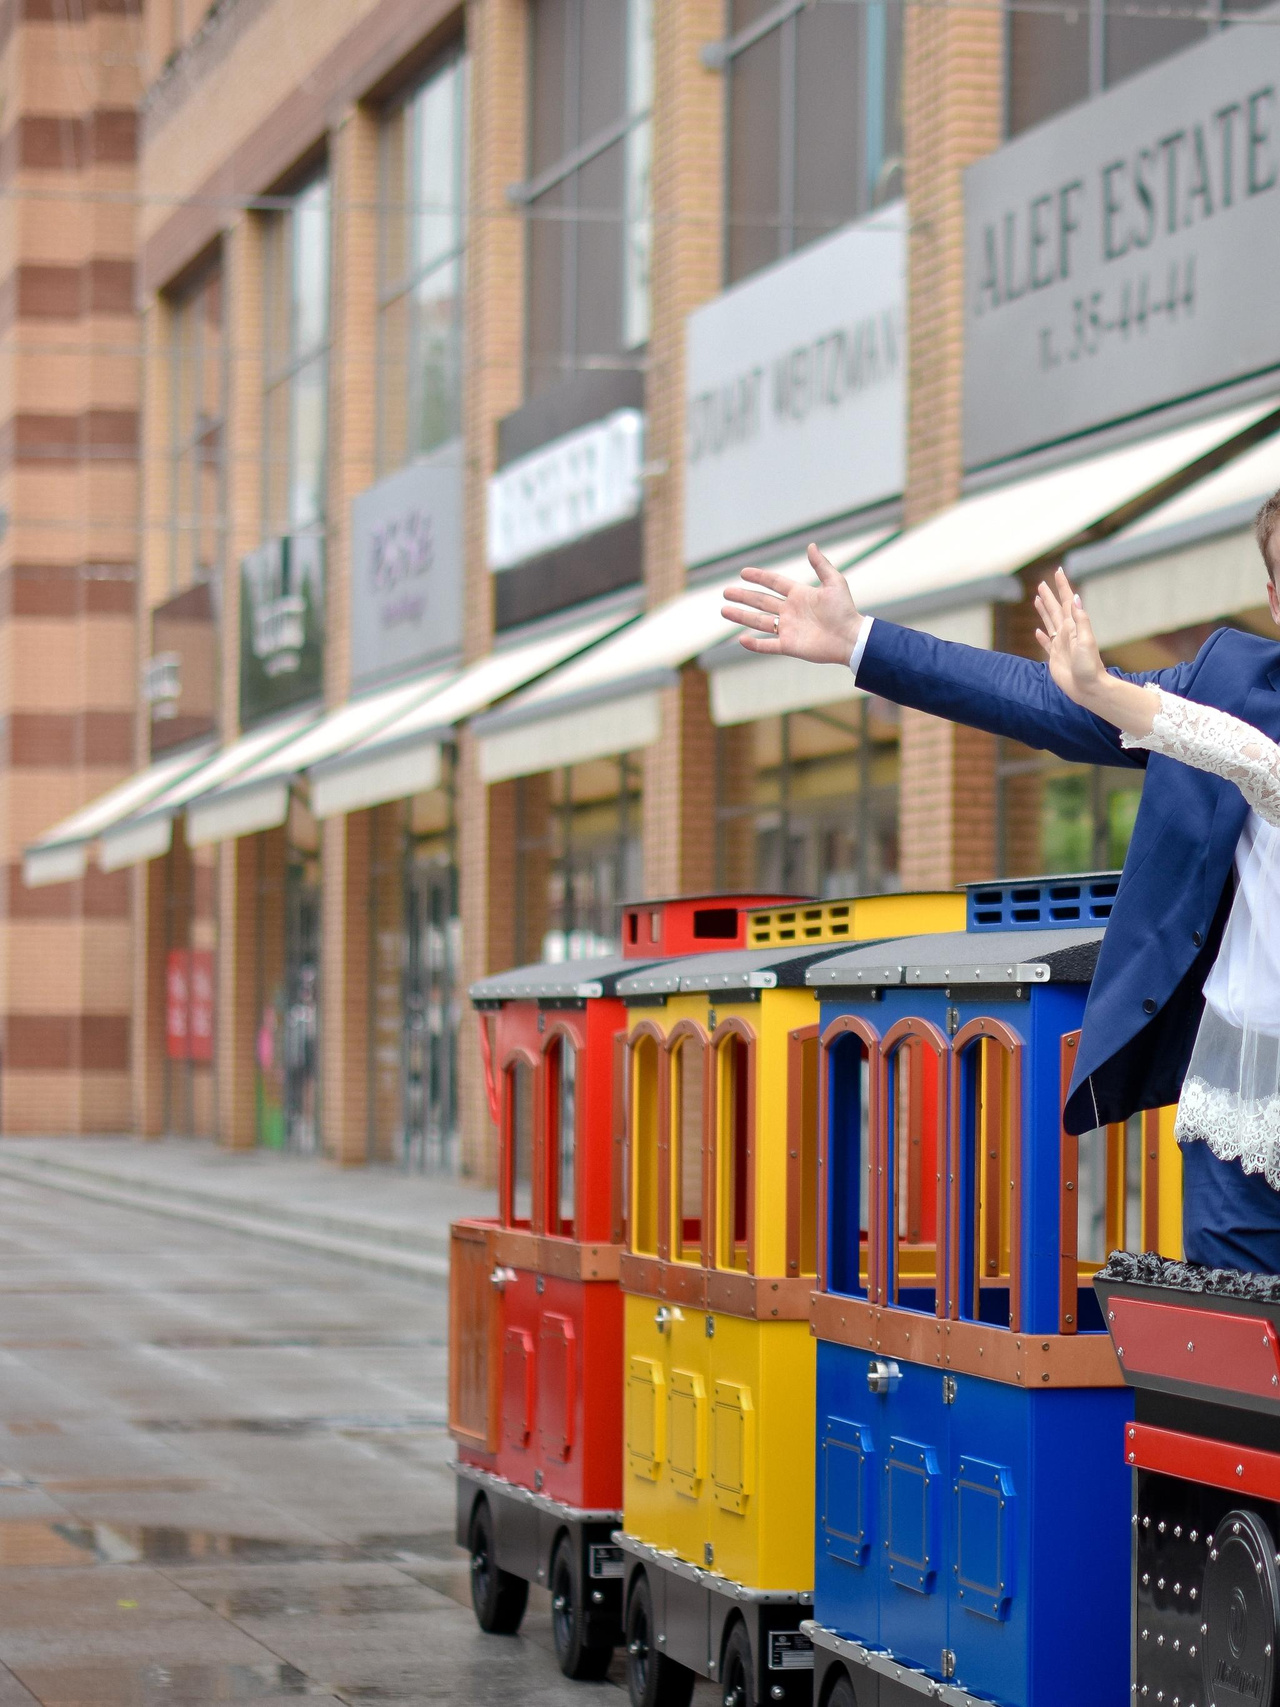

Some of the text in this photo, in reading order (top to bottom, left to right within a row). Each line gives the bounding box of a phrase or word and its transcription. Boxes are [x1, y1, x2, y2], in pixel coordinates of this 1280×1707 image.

[976, 84, 1278, 316] ALEF ESTATE
[1069, 254, 1196, 362] 35-44-44
